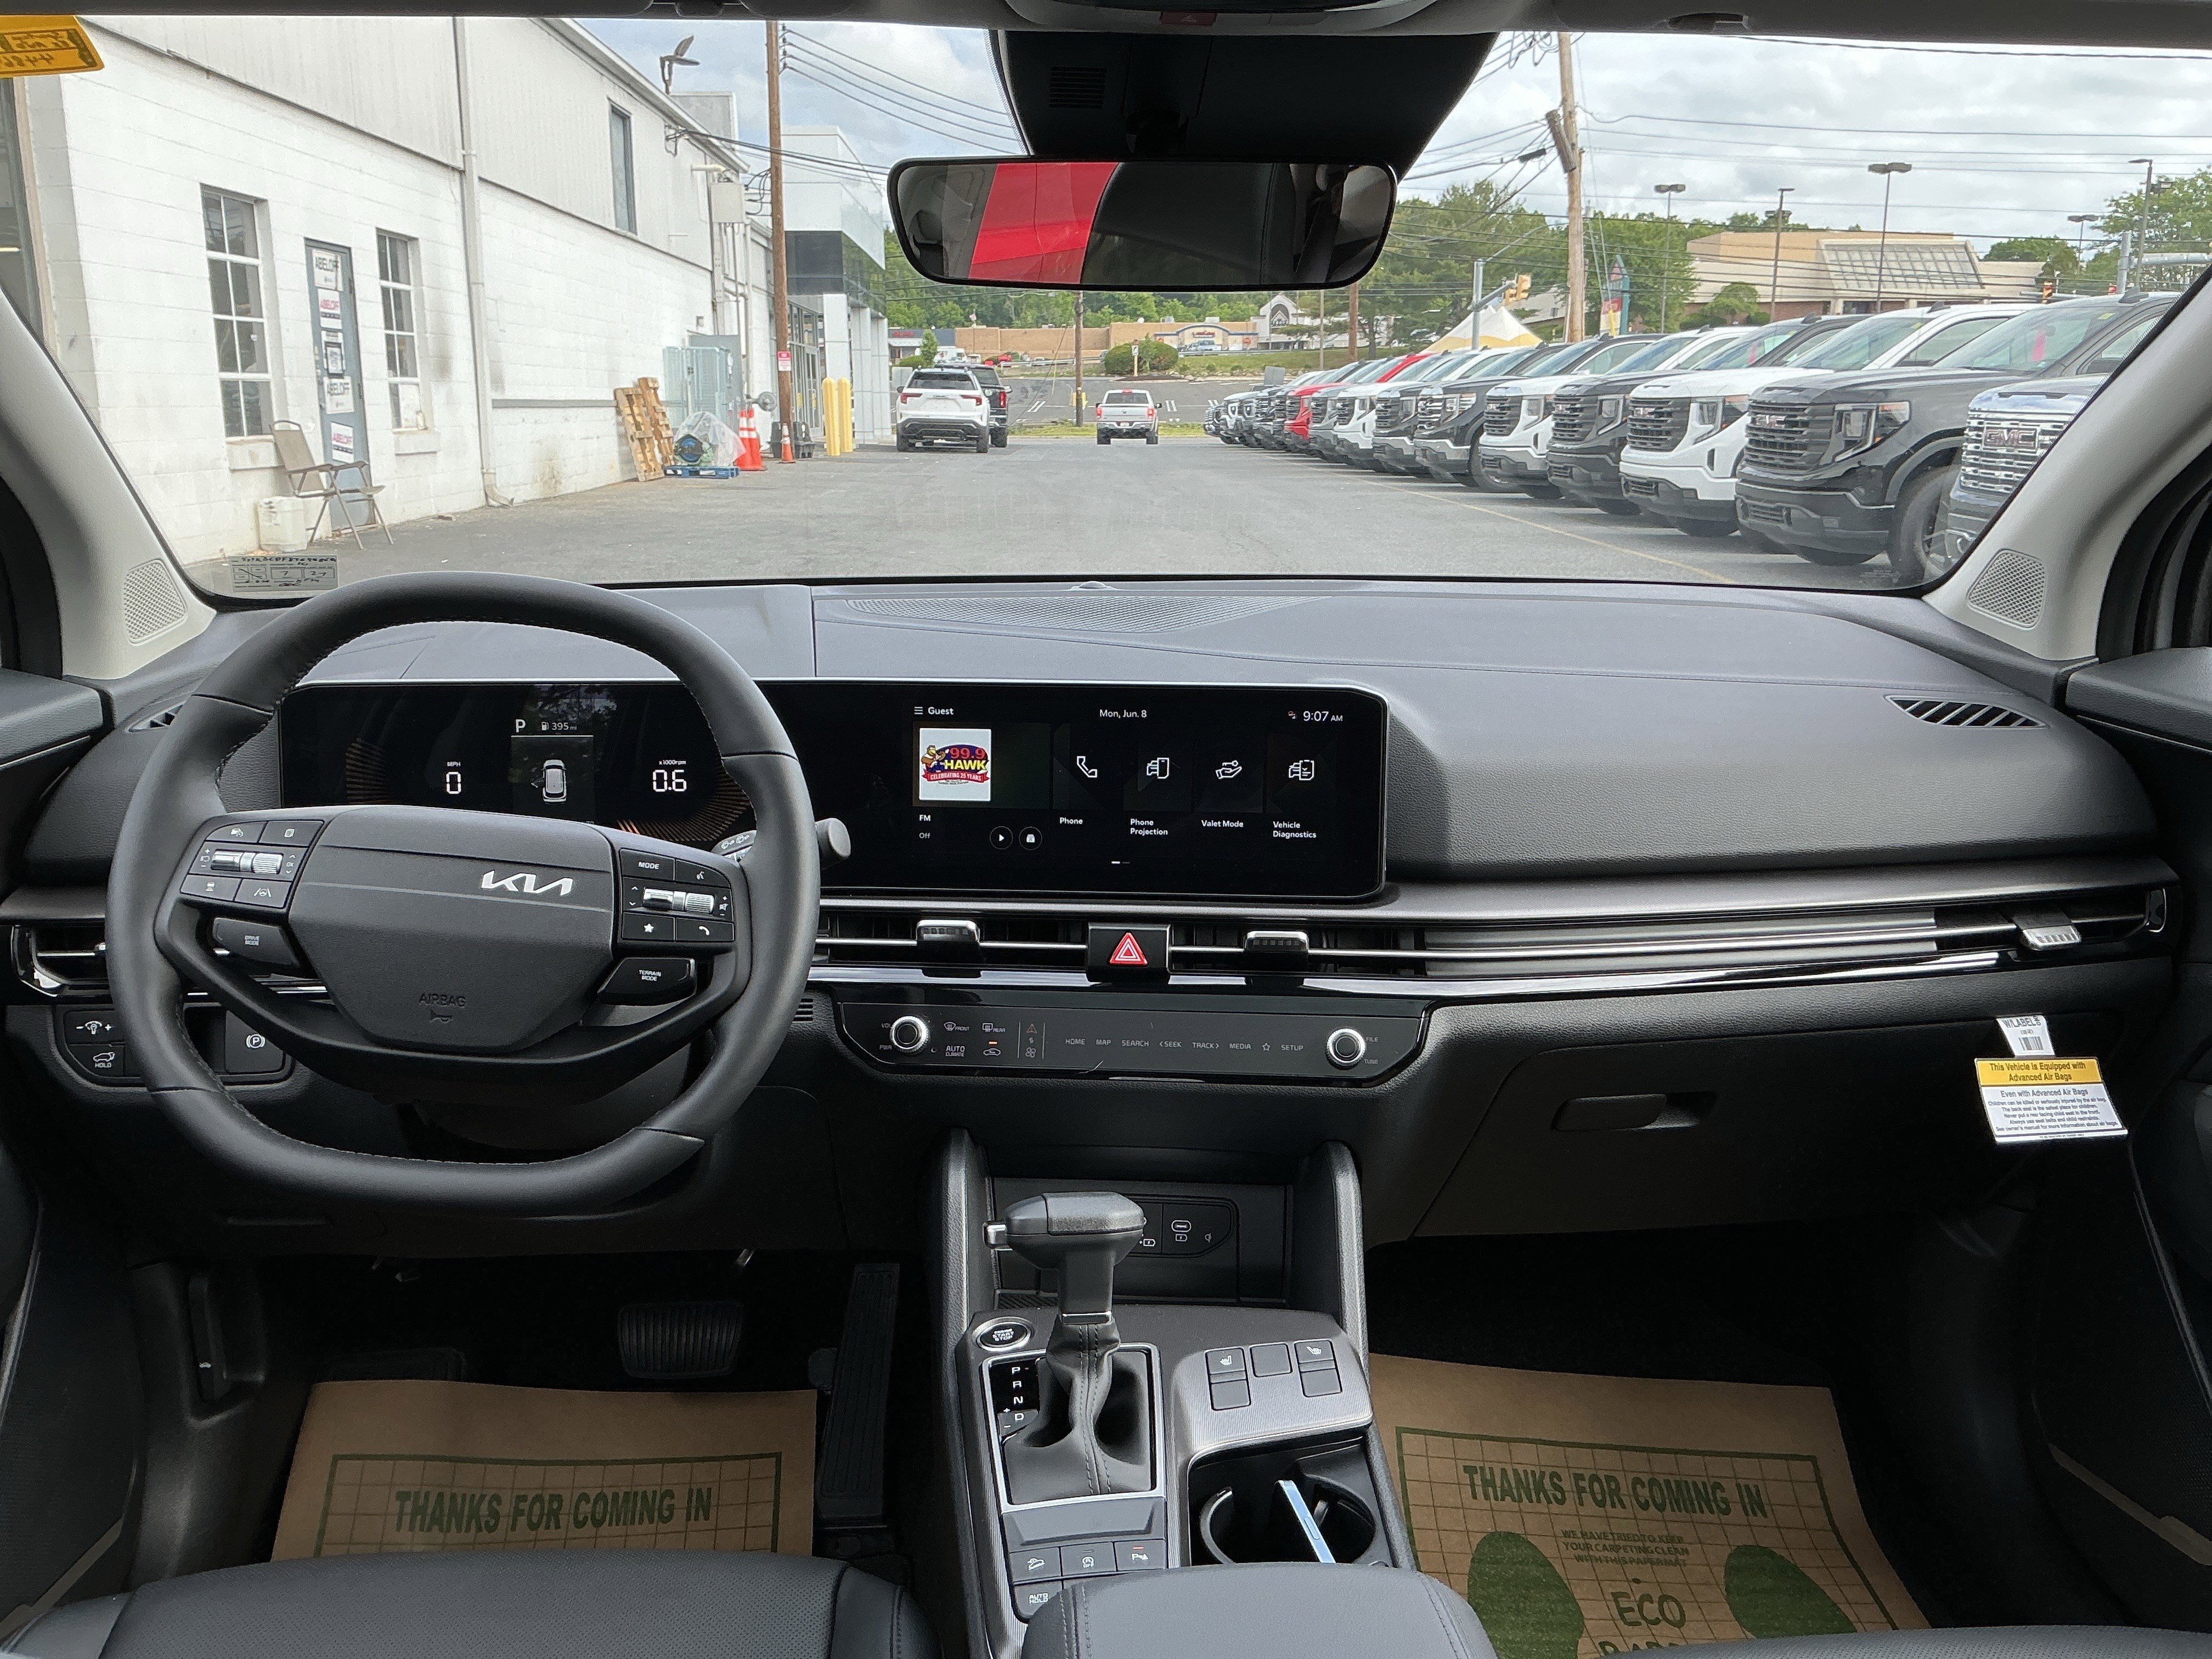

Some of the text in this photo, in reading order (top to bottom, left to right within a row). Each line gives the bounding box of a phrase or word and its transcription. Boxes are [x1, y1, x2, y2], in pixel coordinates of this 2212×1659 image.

[1985, 428, 2035, 446] GMC
[928, 707, 953, 715] Guest
[1099, 709, 1120, 719] Mon,
[1303, 711, 1329, 721] 9:07
[515, 719, 526, 733] P
[551, 722, 569, 730] 395
[950, 747, 985, 759] 99.9
[944, 759, 986, 770] HAWK
[445, 771, 461, 794] 0
[652, 769, 687, 792] 0.6
[1130, 827, 1169, 836] Projection
[1273, 830, 1317, 839] Diagnostics
[638, 861, 660, 870] MODE
[481, 870, 574, 896] KIA
[639, 969, 662, 977] TERRAIN
[1990, 1063, 2005, 1071] This
[2005, 1062, 2030, 1071] Vehicle
[2039, 1062, 2070, 1072] Equipped
[2072, 1061, 2086, 1070] with
[2009, 1072, 2072, 1082] Advanced Air Bags
[2072, 1088, 2089, 1097] Bags
[1012, 1367, 1021, 1375] P
[1013, 1380, 1022, 1389] R
[1014, 1396, 1023, 1405] N
[1015, 1413, 1024, 1422] D
[1463, 1465, 1767, 1518] THANKS FOR COMING IN
[395, 1487, 712, 1533] THANKS FOR COMING IN
[1561, 1530, 1684, 1544] WE HAVE TRIED TO KEEP
[1562, 1541, 1689, 1556] YOUR CARPETING CLEAN
[1573, 1554, 1602, 1564] WITH
[1606, 1556, 1628, 1565] THIS
[1611, 1592, 1686, 1628] ECO
